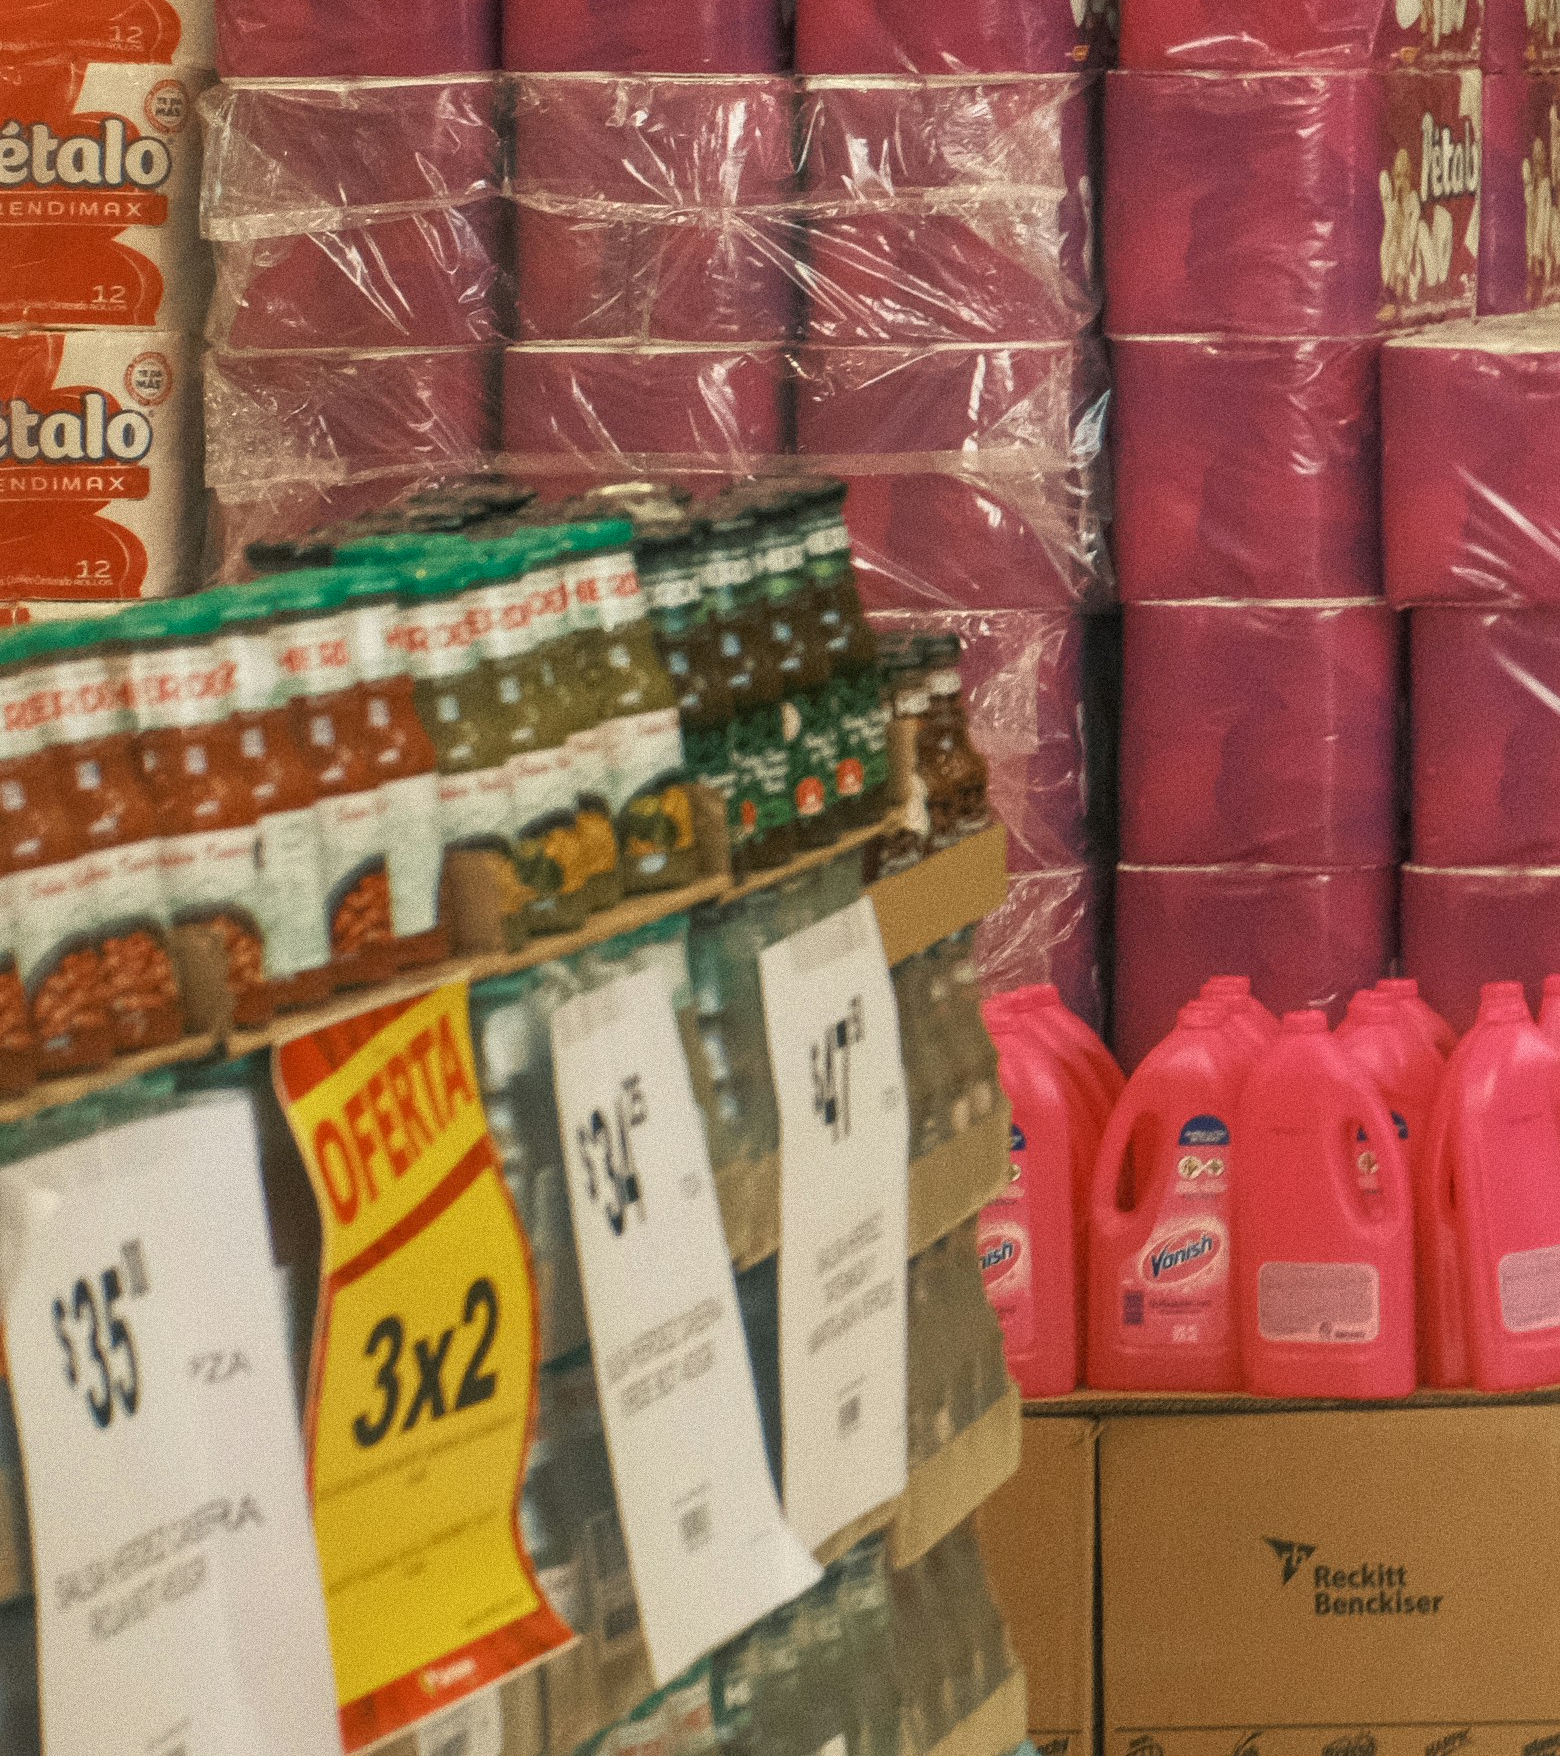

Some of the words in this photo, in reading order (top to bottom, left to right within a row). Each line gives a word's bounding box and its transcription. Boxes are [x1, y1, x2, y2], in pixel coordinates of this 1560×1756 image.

[76, 559, 111, 578] 12
[314, 1014, 475, 1225] OFERTA
[1149, 1229, 1215, 1280] Vanish
[354, 1276, 501, 1449] 3x2
[1313, 1563, 1408, 1590] Reckitt
[1313, 1589, 1444, 1617] Benckiser
